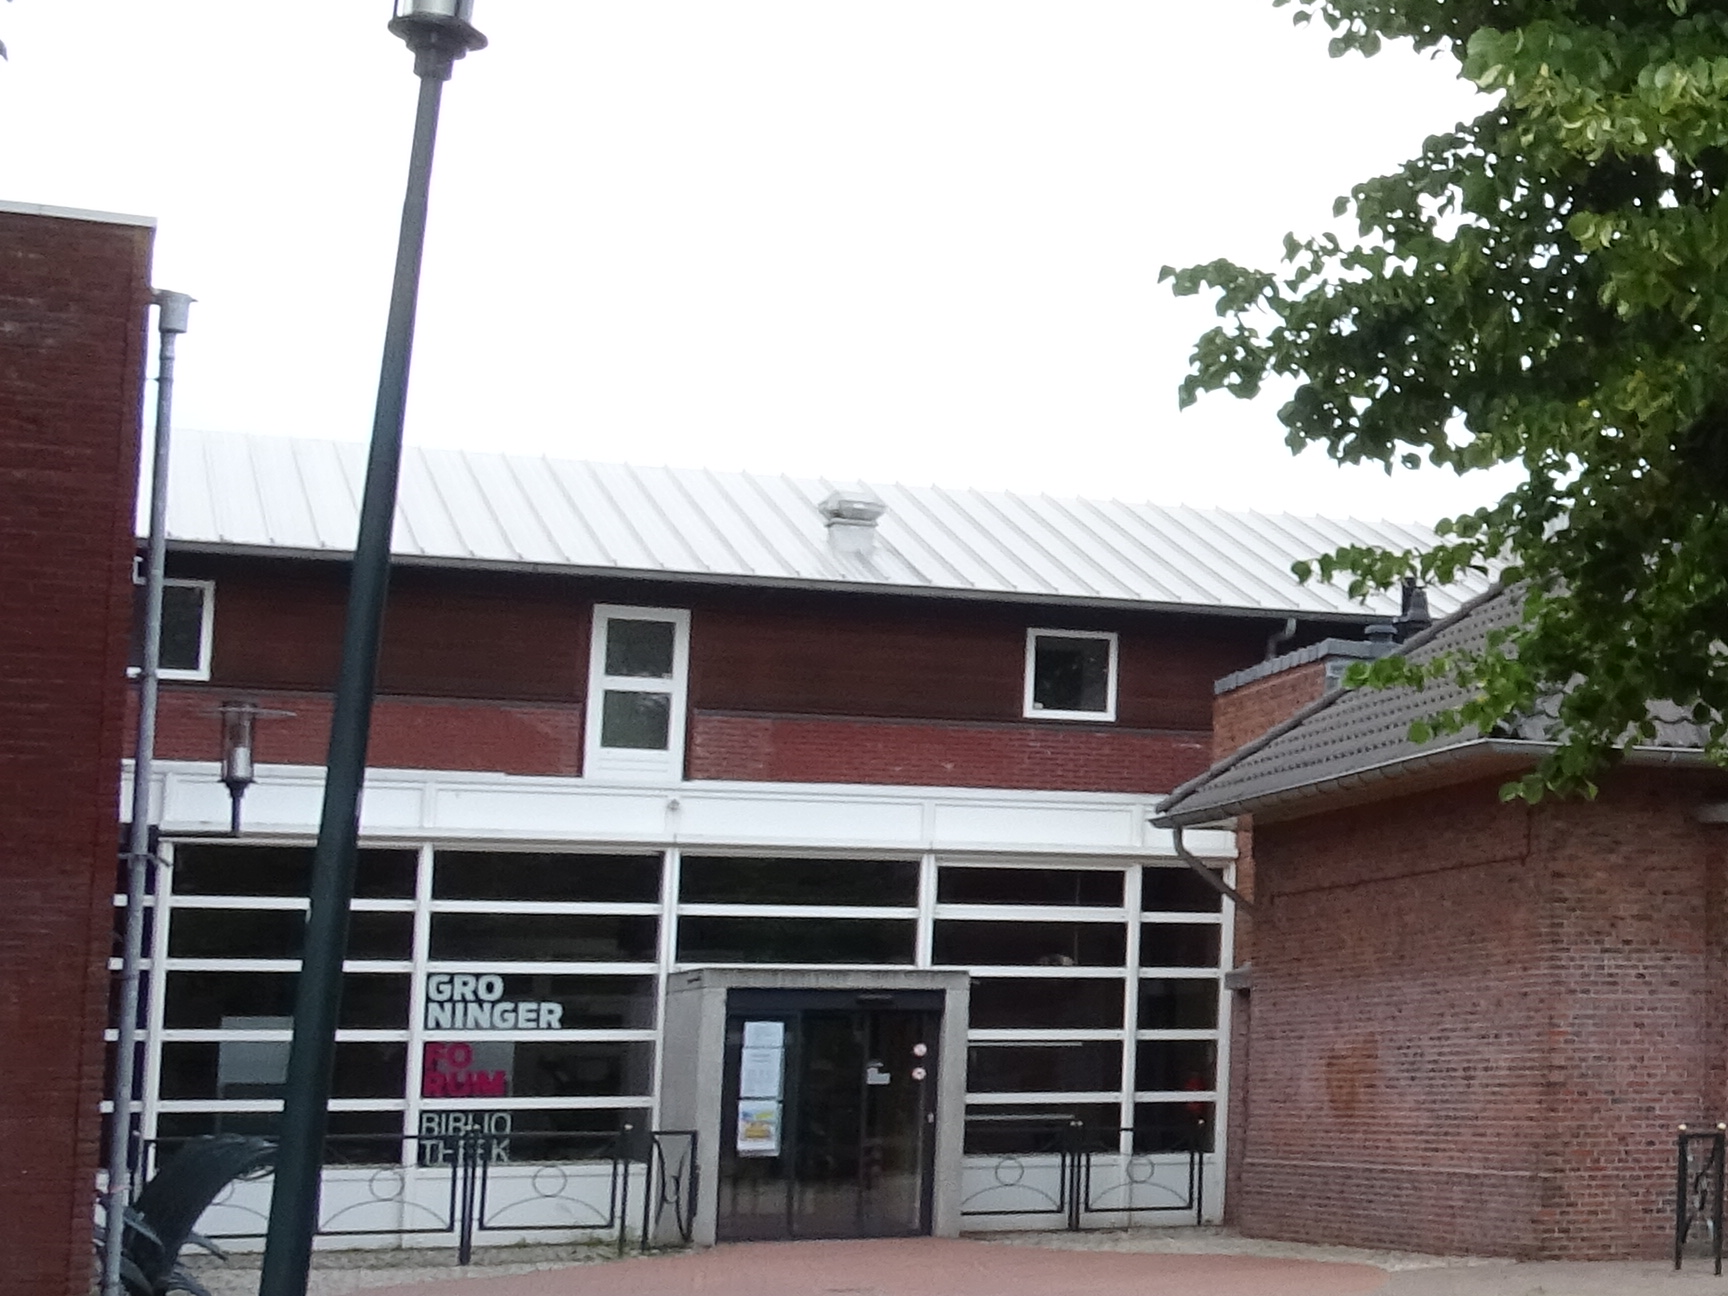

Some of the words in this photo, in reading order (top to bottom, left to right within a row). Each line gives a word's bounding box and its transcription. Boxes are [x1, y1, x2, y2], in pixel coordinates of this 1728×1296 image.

[428, 974, 504, 1002] GRO
[427, 1002, 564, 1029] NINGER
[424, 1043, 473, 1069] FO
[424, 1070, 507, 1097] RUM
